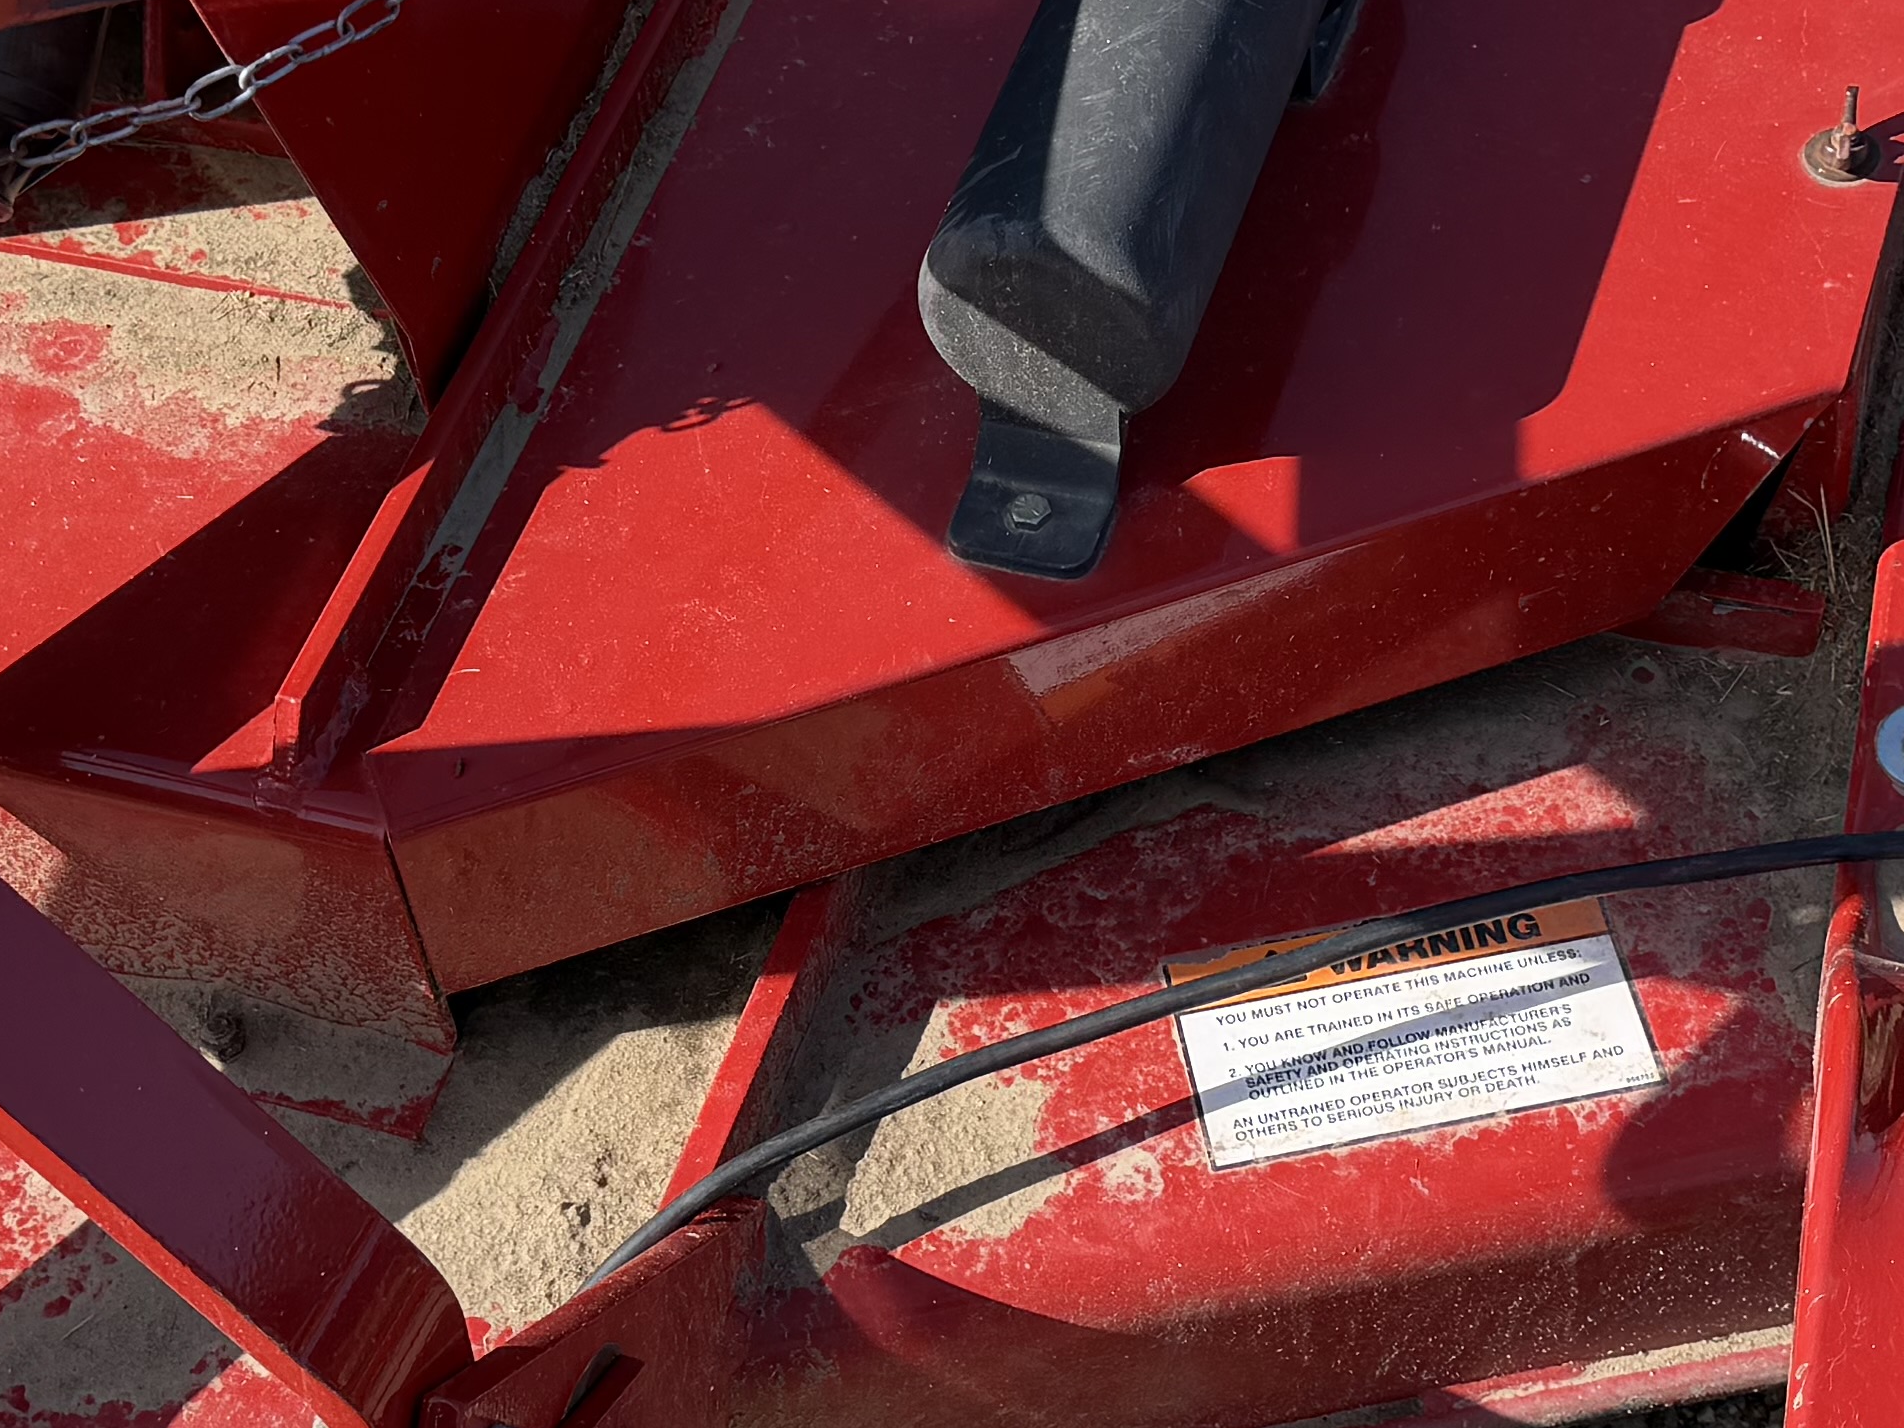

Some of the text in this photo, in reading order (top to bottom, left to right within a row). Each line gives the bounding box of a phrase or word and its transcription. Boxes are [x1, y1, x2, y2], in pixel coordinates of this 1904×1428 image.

[1214, 947, 1583, 1026] YOU MUST NOT OPERATE THIS MACHINE UNLESS:
[1222, 971, 1591, 1052] 1. YOU ARE TRAINED IN ITS SAFE OPERATION AND
[1227, 1067, 1241, 1078] 2.
[1244, 1059, 1277, 1075] YOU
[1279, 1049, 1328, 1069] KNOW
[1330, 1041, 1365, 1058] AND
[1366, 1028, 1433, 1051] FOLLOW
[1232, 1044, 1624, 1130] AN UNTRAINED OPERATOR SUBJECTS HIMSELF AND
[1244, 1015, 1572, 1089] SAFETY AND OPERATING INSTRUCTIONS AS
[1247, 1076, 1325, 1101] OUTLINED
[1327, 1072, 1345, 1086] IN
[1347, 1065, 1380, 1081] THE
[1481, 1034, 1552, 1056] MANUAL.
[1234, 1073, 1540, 1142] OTHERS TO SERIOUS INJURY OR DEATH.
